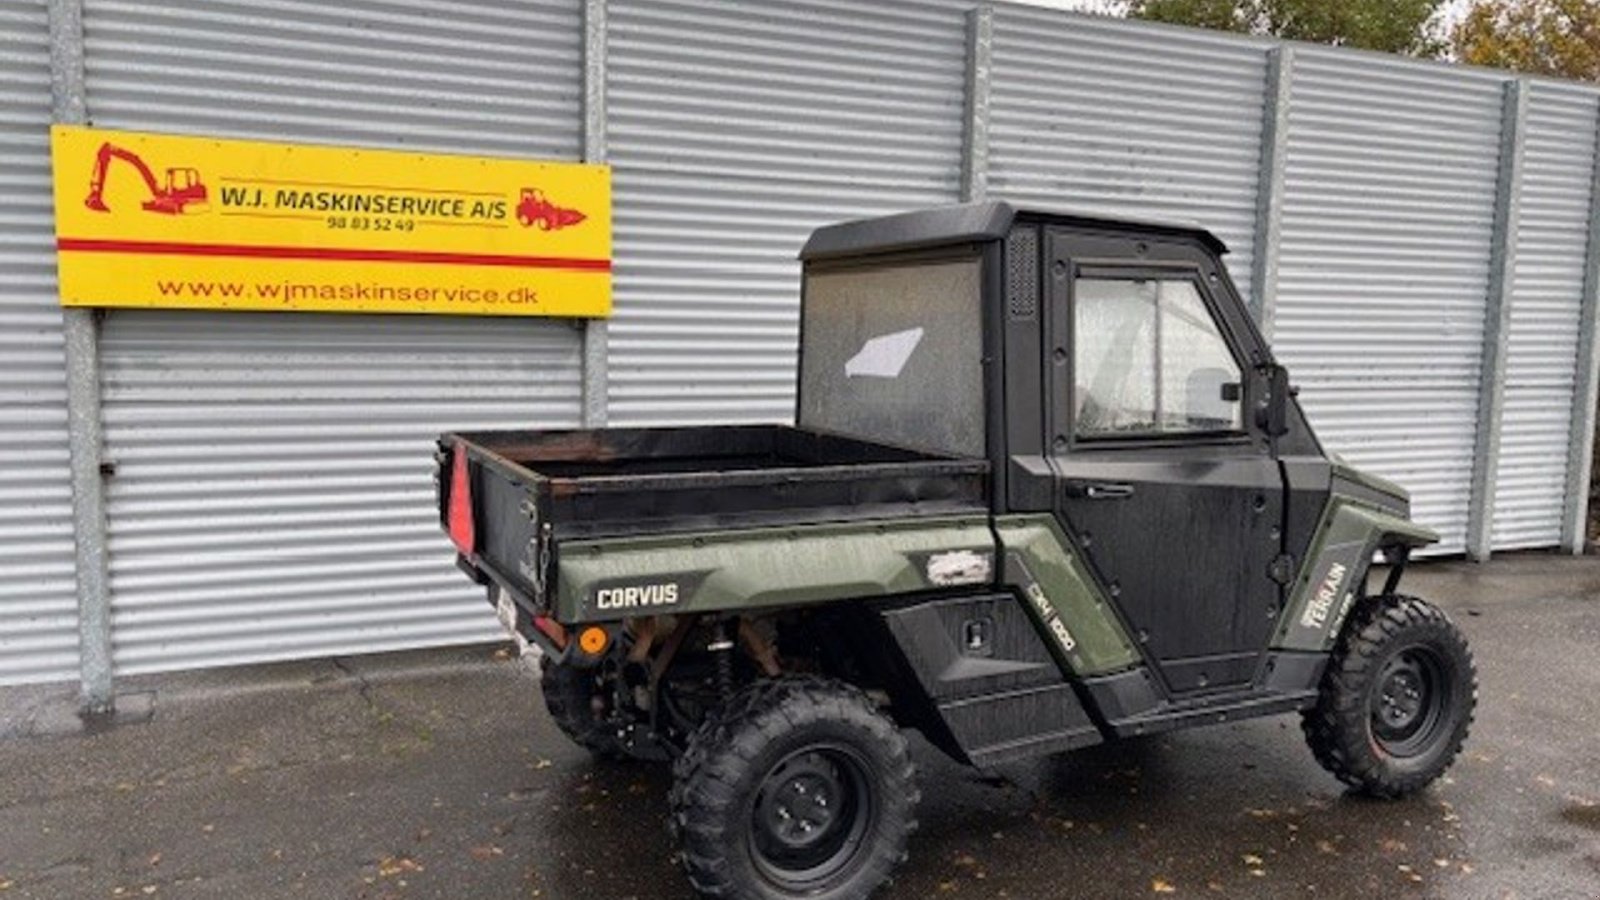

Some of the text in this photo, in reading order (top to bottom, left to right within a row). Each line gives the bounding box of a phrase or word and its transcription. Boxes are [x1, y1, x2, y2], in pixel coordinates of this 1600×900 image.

[221, 187, 507, 219] W.J. MASKINSERVICE A/S
[327, 216, 415, 232] 98 83 52 49
[157, 279, 539, 304] www.wjmaskinservice.dk
[597, 582, 679, 609] CORVUS
[1307, 562, 1346, 629] TERRAIN
